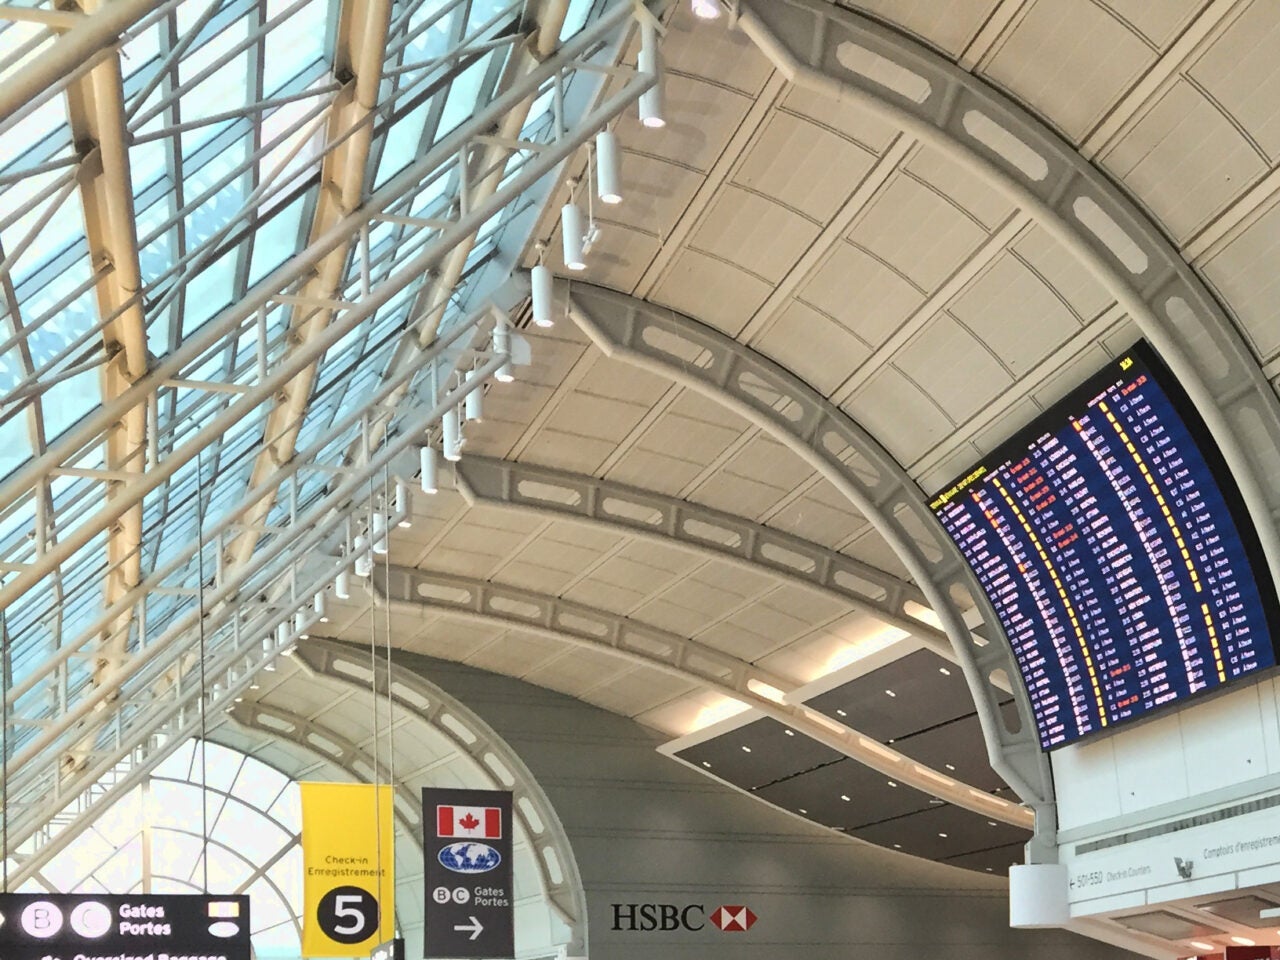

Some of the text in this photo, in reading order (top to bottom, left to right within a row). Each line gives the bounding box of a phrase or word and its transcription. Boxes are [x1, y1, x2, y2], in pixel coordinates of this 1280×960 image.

[325, 855, 368, 865] Check-in
[308, 867, 386, 878] Enregistrement
[437, 890, 447, 901] B
[456, 890, 465, 901] C
[474, 886, 504, 898] Gates
[474, 896, 509, 907] Portes
[119, 903, 165, 918] Gates
[334, 895, 366, 935] 5
[34, 909, 51, 929] B
[611, 903, 705, 931] HSBC
[119, 921, 171, 936] Portes
